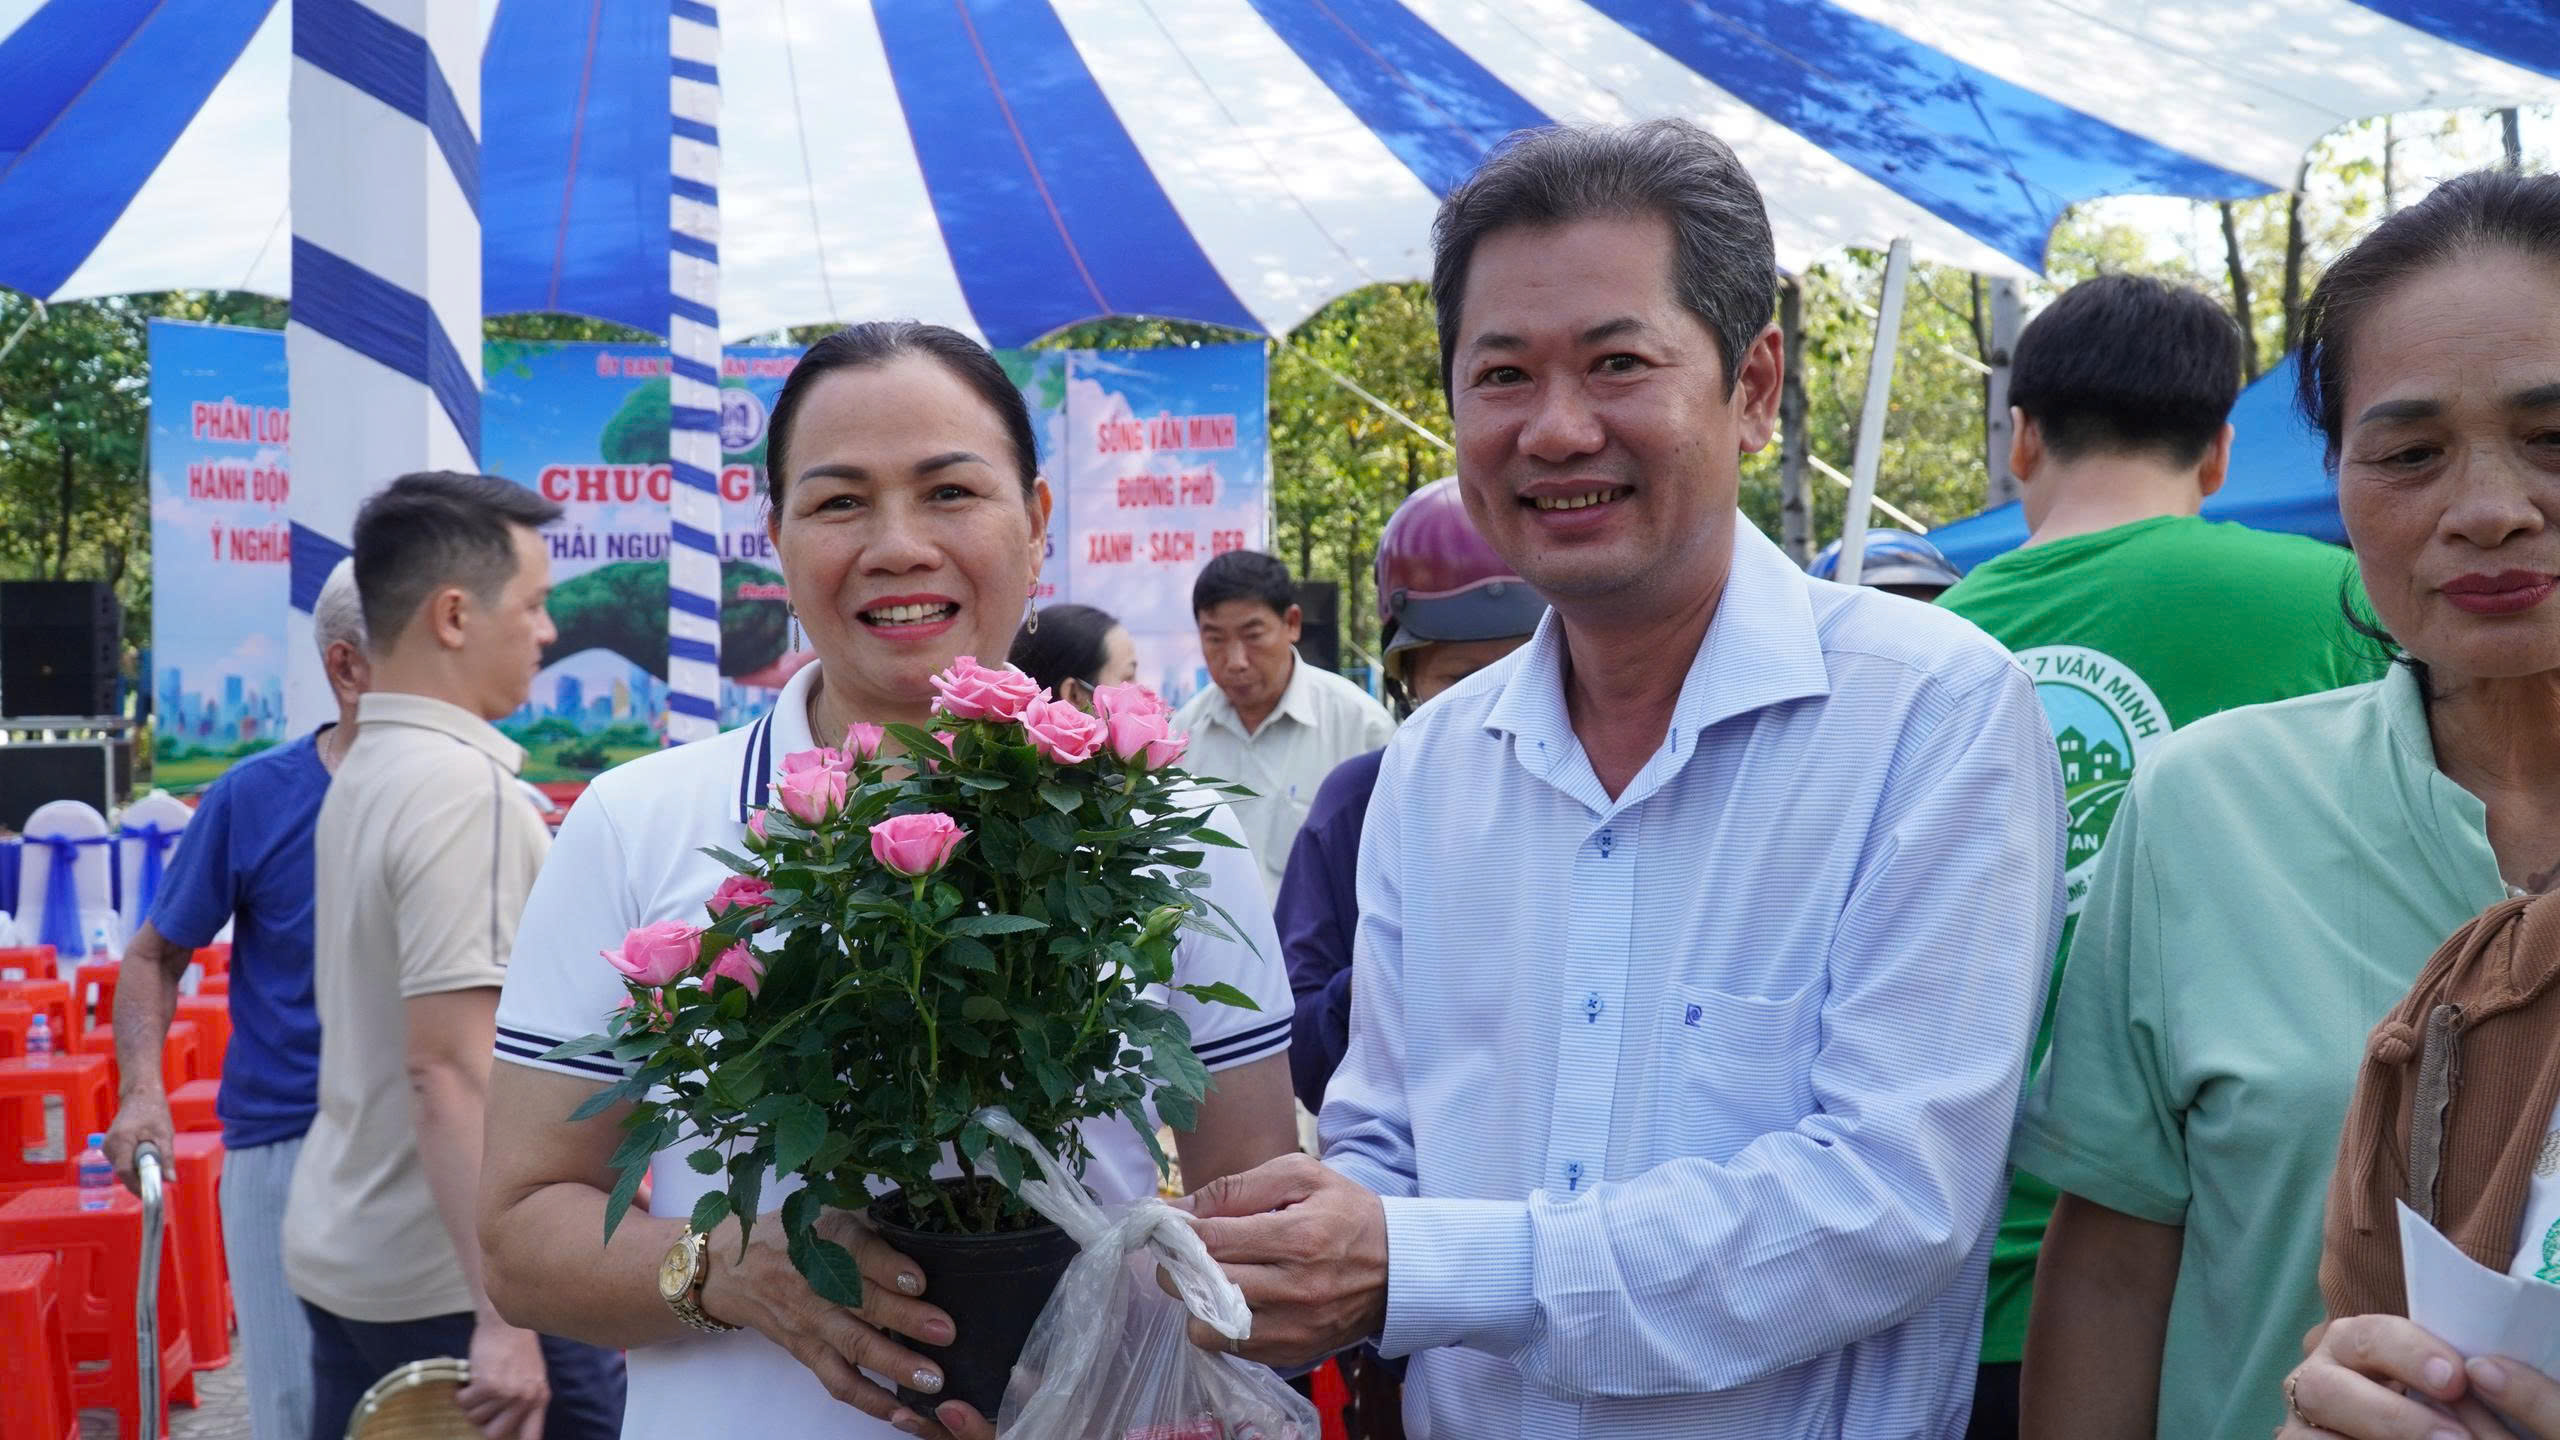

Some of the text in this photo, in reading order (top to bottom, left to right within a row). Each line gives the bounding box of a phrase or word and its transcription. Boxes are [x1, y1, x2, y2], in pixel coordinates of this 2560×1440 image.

[194, 397, 251, 440] PHÂN
[1188, 417, 1235, 448] MINH
[188, 459, 289, 512] HÀNH ĐỘN
[541, 468, 750, 502] CHƯƠG
[1088, 533, 1132, 563] XANH
[2036, 653, 2160, 739] 7 VĂN MINH
